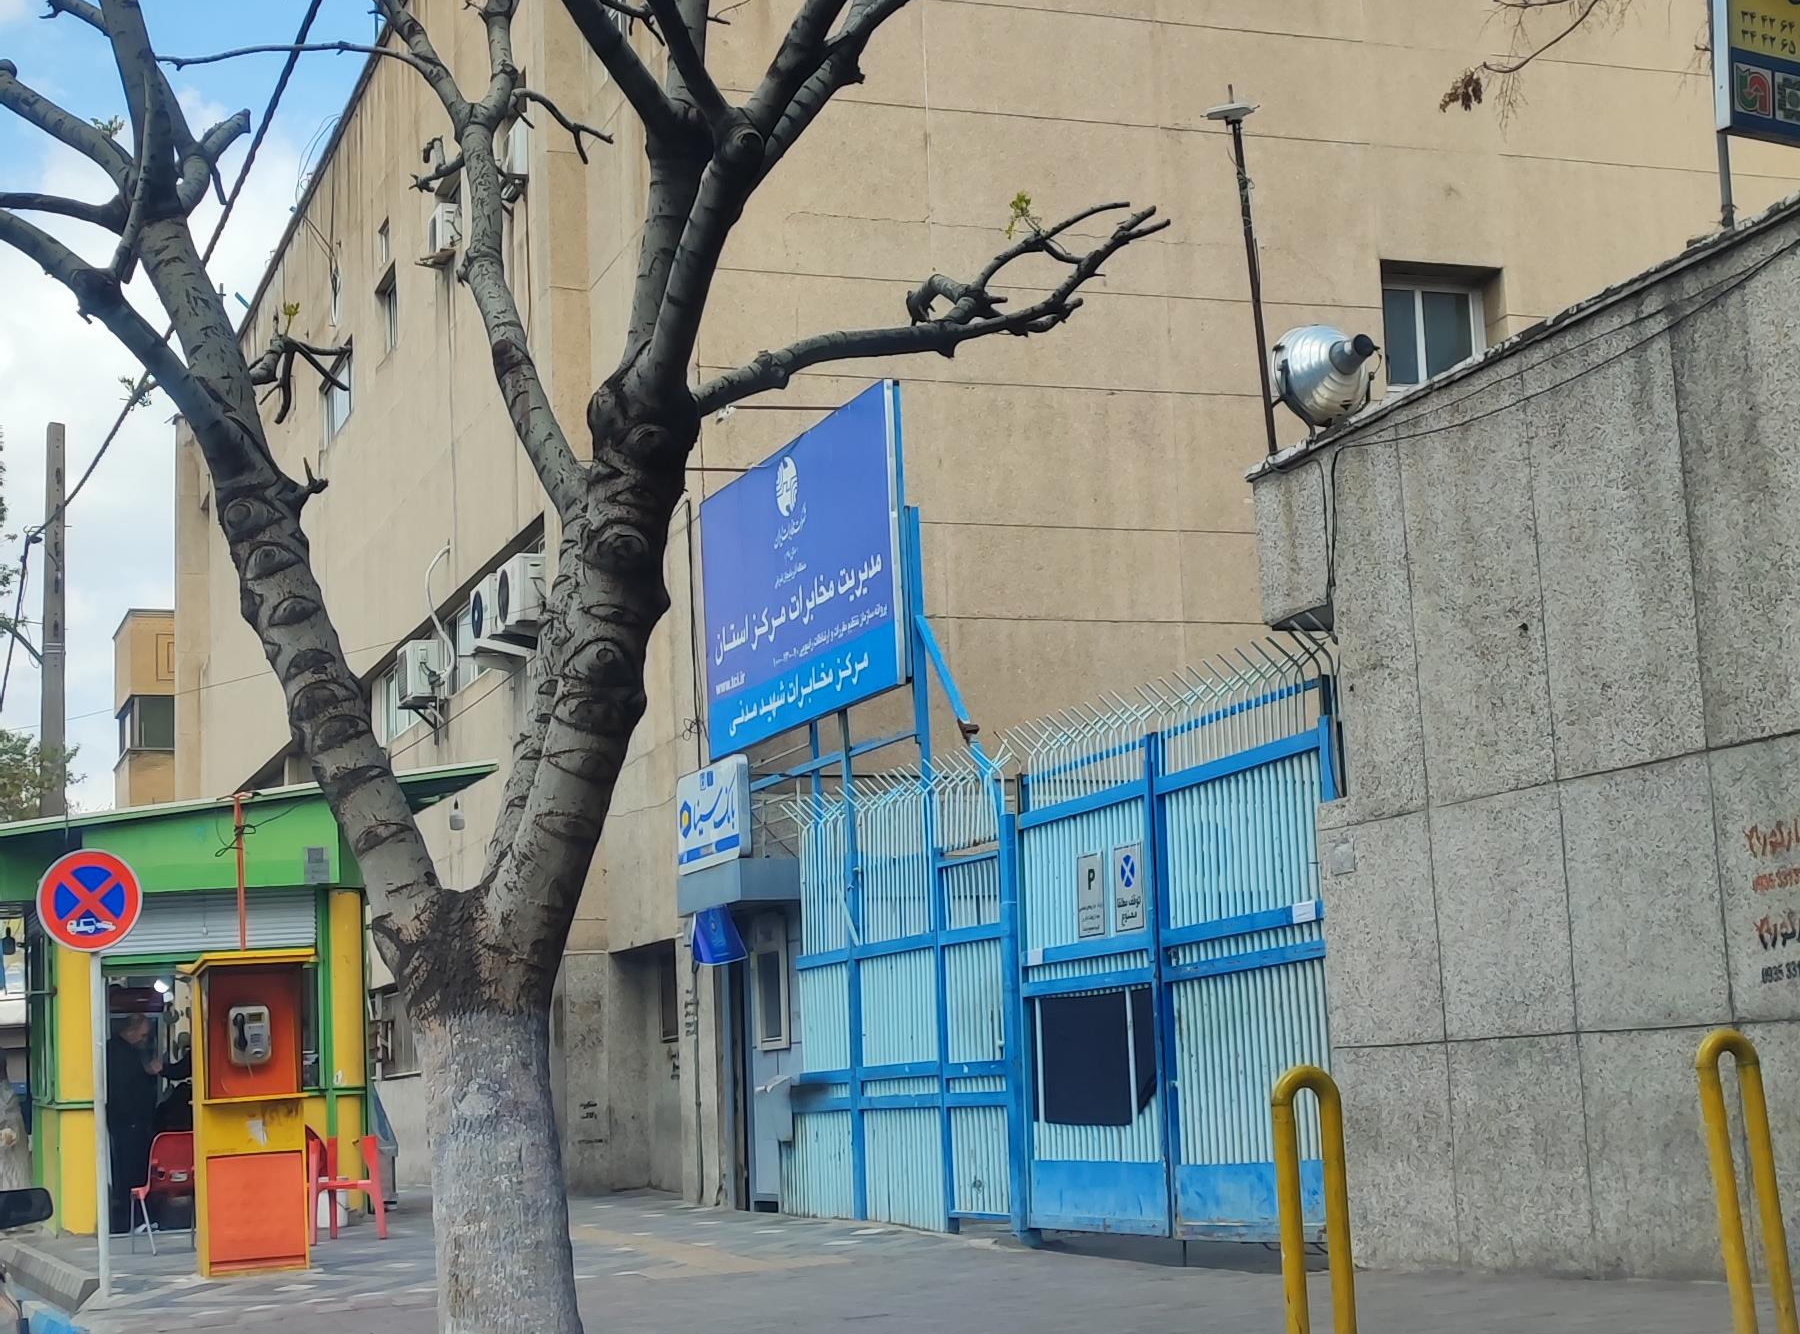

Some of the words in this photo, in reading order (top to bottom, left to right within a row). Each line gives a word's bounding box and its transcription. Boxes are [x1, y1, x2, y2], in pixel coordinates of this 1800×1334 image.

[789, 574, 835, 624] مخابرات
[838, 553, 882, 602] مدیریت
[715, 613, 748, 666] استان
[751, 606, 786, 651] مرکز
[787, 662, 834, 708] مخابرات
[836, 652, 869, 692] مرکز
[729, 700, 758, 737] مدنی
[760, 680, 785, 722] شهید
[693, 786, 722, 836] سینا
[713, 769, 737, 829] بانک
[1088, 869, 1095, 890] P
